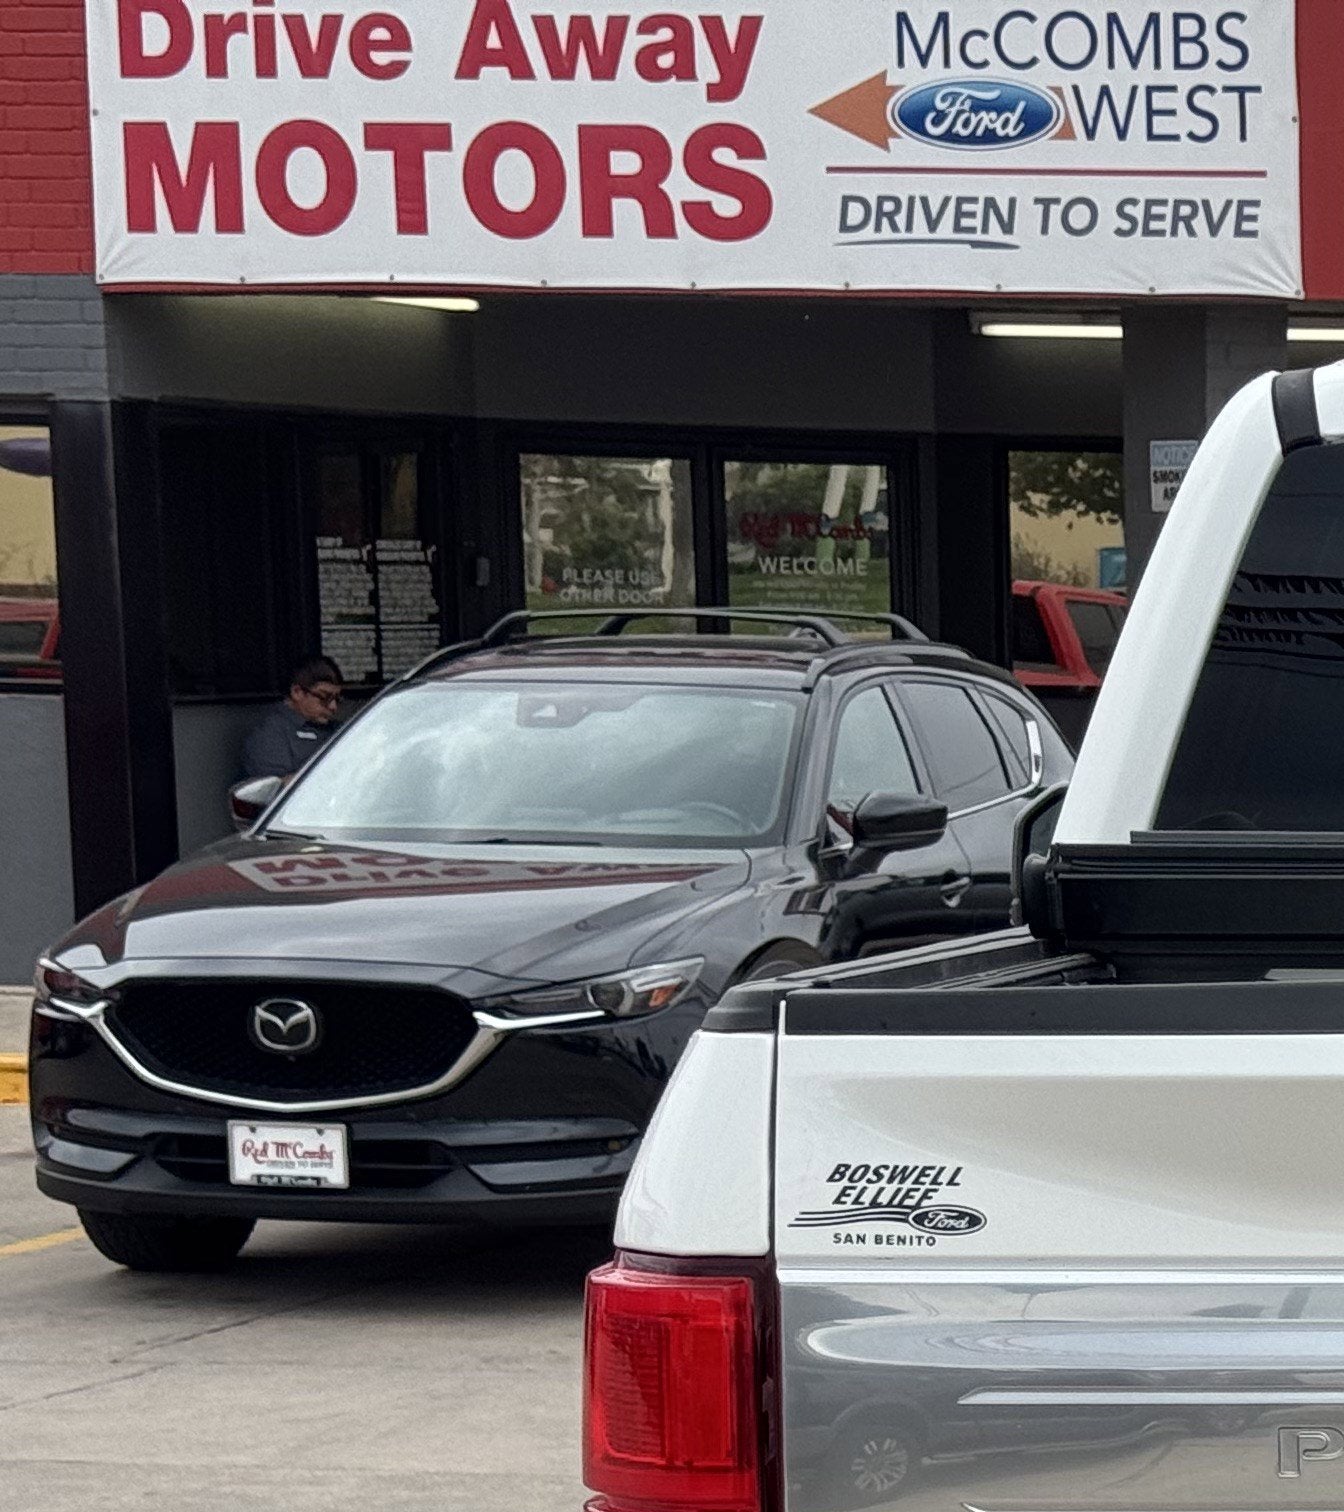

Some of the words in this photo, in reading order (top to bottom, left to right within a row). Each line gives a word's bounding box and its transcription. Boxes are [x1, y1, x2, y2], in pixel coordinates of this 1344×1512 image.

[116, 0, 413, 80] Drive
[454, 0, 764, 103] Away
[895, 10, 1250, 72] McCOMBS
[923, 86, 1028, 139] Ford
[1071, 84, 1263, 143] WEST
[122, 118, 774, 243] MOTORS
[838, 194, 1018, 236] DRIVEN
[1033, 196, 1099, 237] TO
[1113, 198, 1262, 239] SERVE
[562, 567, 625, 585] PLEASE
[758, 555, 868, 576] WELCOME
[826, 1163, 964, 1187] BOSWELL
[833, 1232, 867, 1245] SAN
[874, 1233, 937, 1247] BENITO
[923, 1209, 971, 1229] Ford
